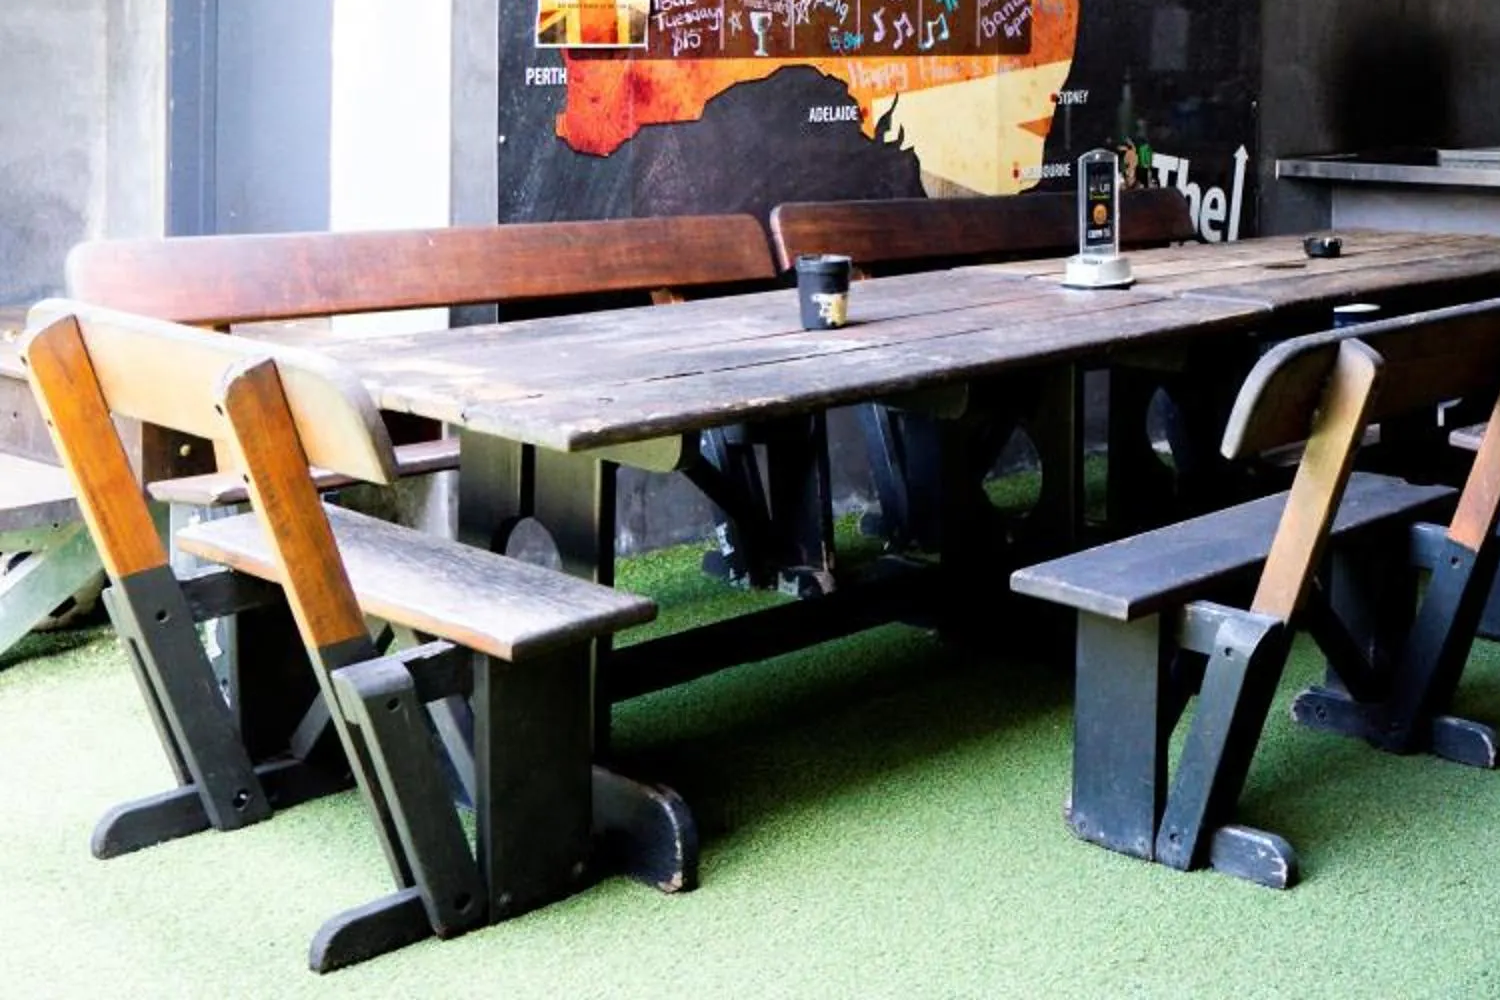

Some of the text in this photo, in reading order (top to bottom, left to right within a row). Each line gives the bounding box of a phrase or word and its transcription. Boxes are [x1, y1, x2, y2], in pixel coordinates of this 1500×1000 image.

[525, 66, 568, 86] PERTH
[1058, 89, 1089, 105] SYDNEY
[809, 104, 859, 123] ADELAIDE
